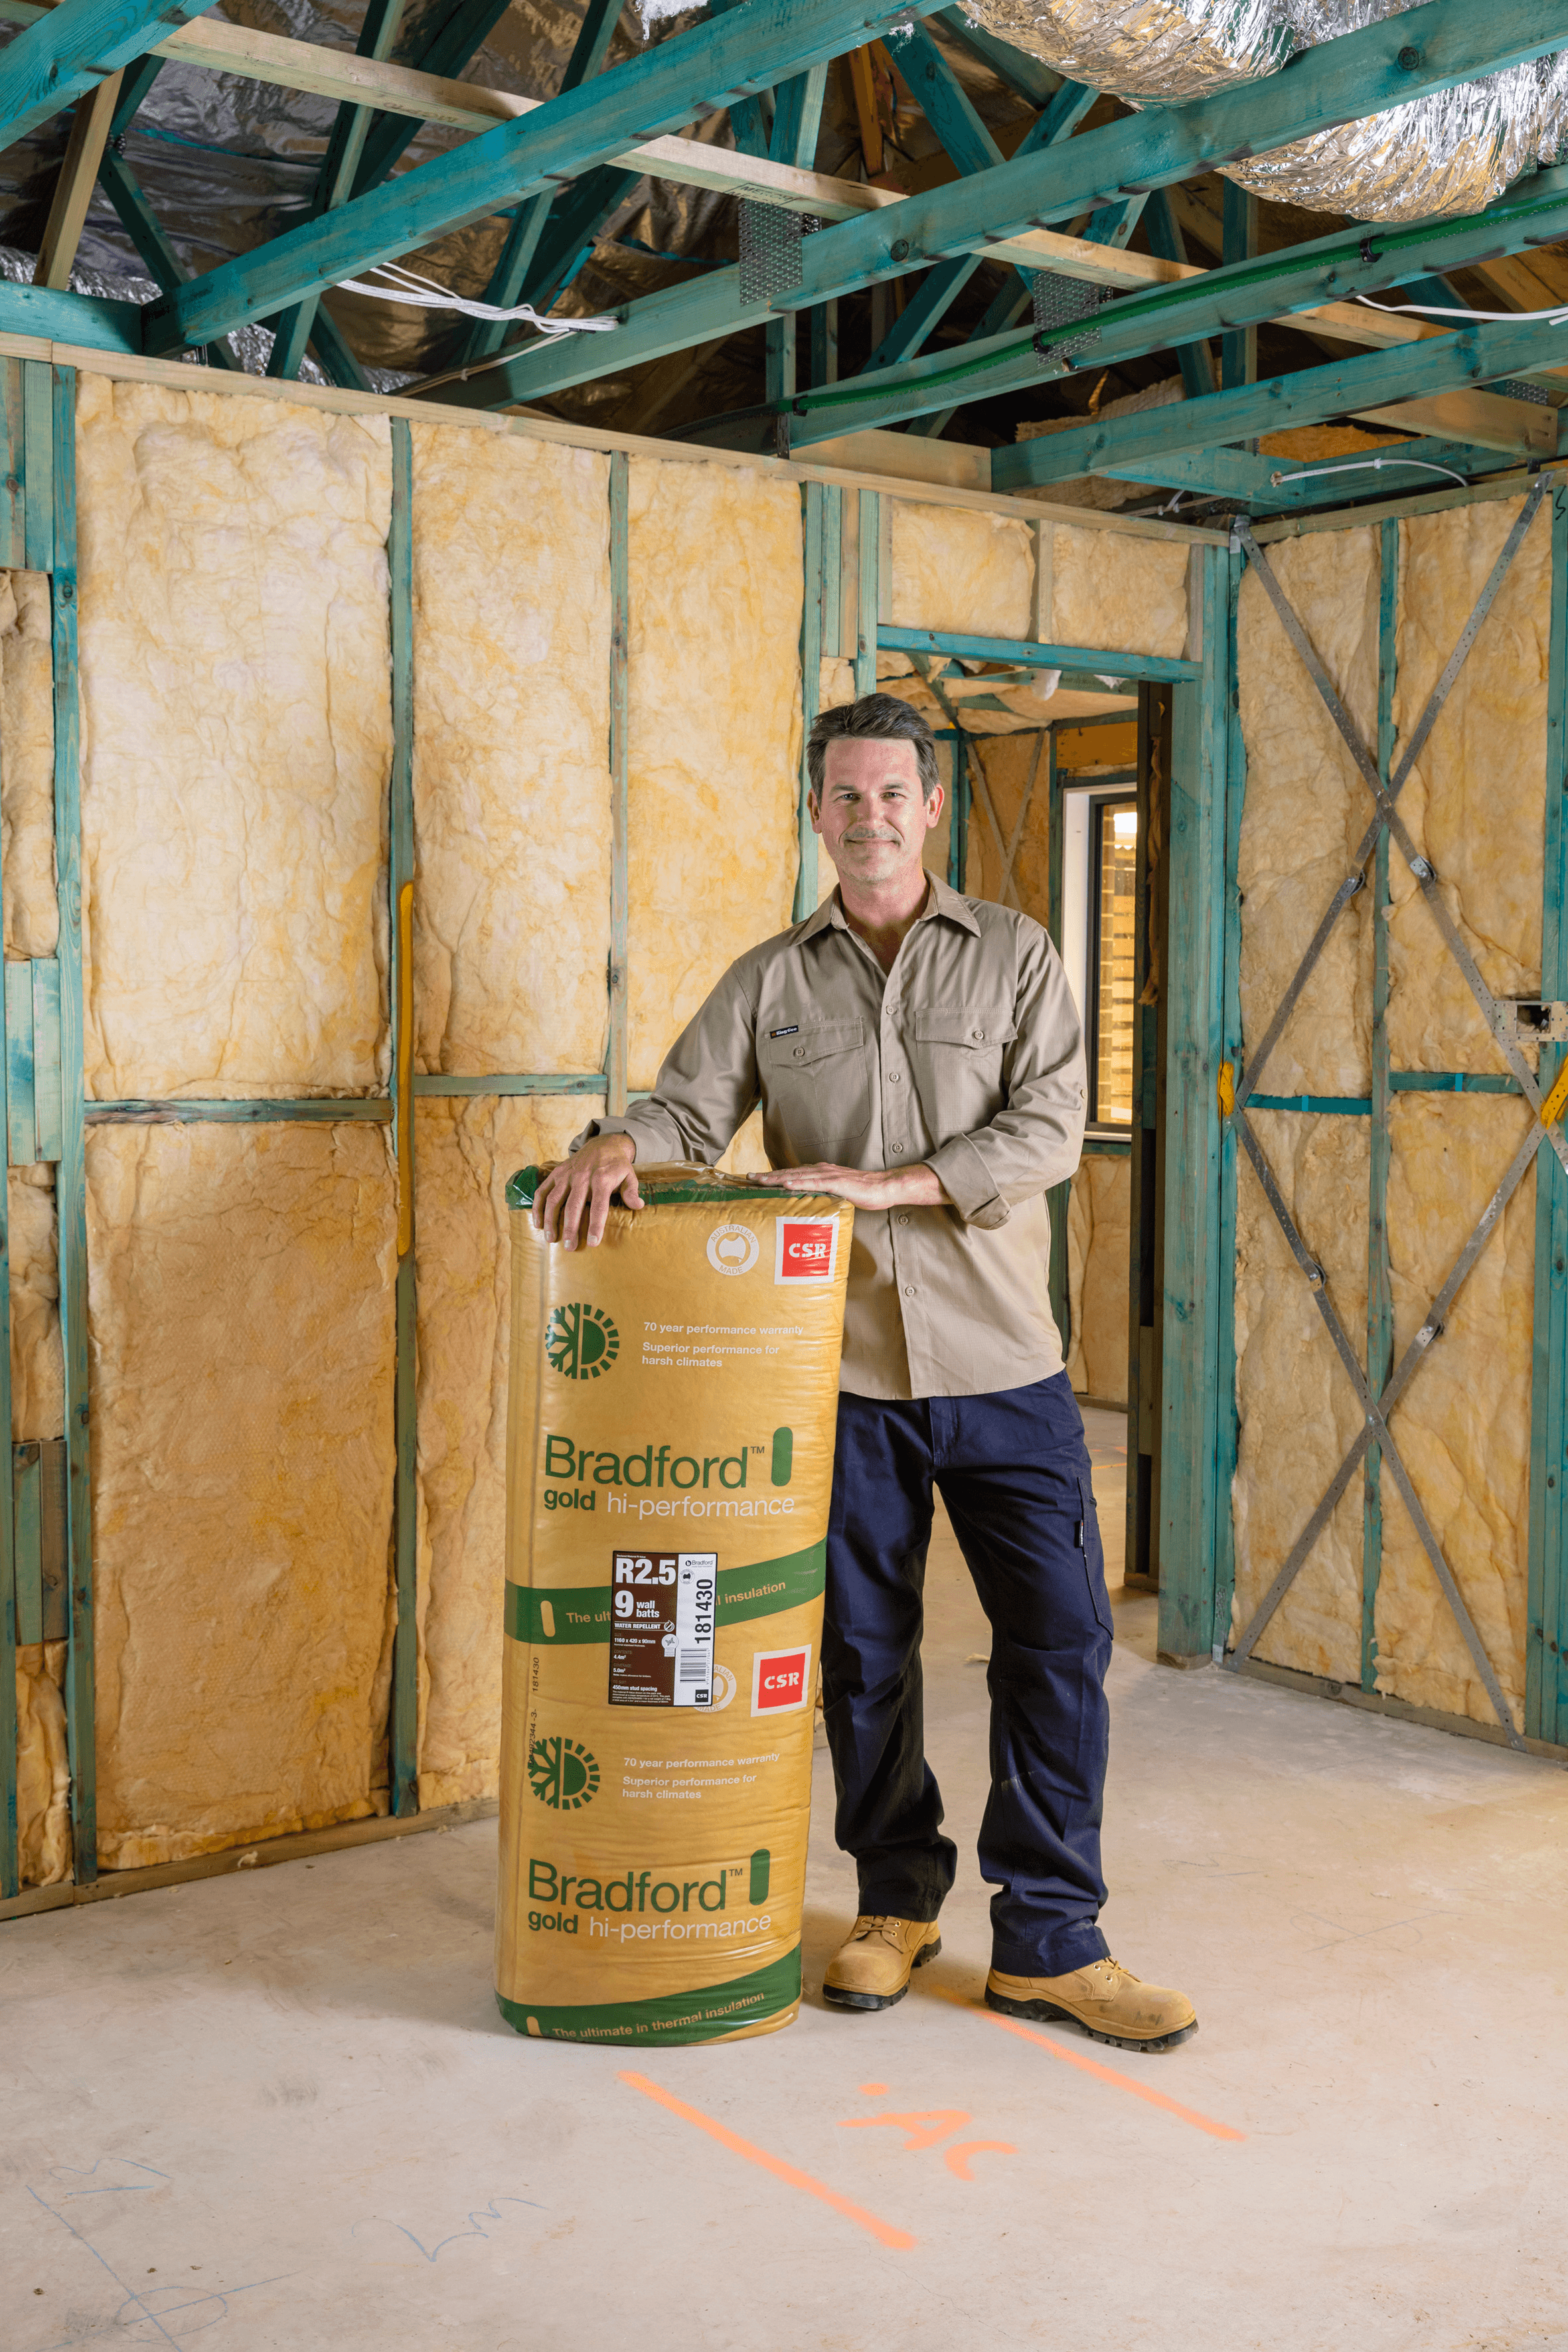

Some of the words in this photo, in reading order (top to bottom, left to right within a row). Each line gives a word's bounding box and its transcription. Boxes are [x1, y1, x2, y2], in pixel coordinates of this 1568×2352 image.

[710, 1225, 756, 1243] AUSTRALIAN
[789, 1243, 826, 1258] CSR
[718, 1265, 744, 1275] MADE
[643, 1322, 657, 1331] 70
[659, 1324, 684, 1334] year
[686, 1324, 756, 1334] performance
[759, 1326, 803, 1336] warranty
[642, 1342, 690, 1354] Superior
[692, 1345, 762, 1355] performance
[765, 1346, 780, 1354] for
[641, 1356, 673, 1366] harsh
[676, 1357, 722, 1367] climates
[543, 1488, 596, 1511] gold
[606, 1492, 795, 1520] hi-performance
[615, 1557, 676, 1585] R2.5
[566, 1611, 591, 1623] The
[724, 1581, 786, 1605] insulation
[615, 1590, 634, 1618] 9
[636, 1600, 655, 1609] wall
[636, 1609, 660, 1618] batts
[694, 1579, 713, 1644] 181430
[714, 1665, 734, 1682] ALIAN
[763, 1672, 800, 1690] CSR
[696, 1703, 722, 1712] MADE
[623, 1757, 637, 1766] 70
[639, 1759, 663, 1768] year
[666, 1758, 734, 1769] performance
[737, 1753, 780, 1765] warranty
[623, 1776, 669, 1787] Superior
[672, 1776, 740, 1788] performance
[742, 1774, 757, 1783] for
[622, 1788, 653, 1798] harsh
[656, 1790, 702, 1799] climates
[527, 1911, 578, 1934] gold
[589, 1915, 771, 1943] hi-performance
[552, 2028, 577, 2038] The
[580, 2025, 633, 2038] ultimate
[636, 2023, 649, 2034] in
[652, 2011, 702, 2031] thermal
[705, 1992, 765, 2019] insulation
